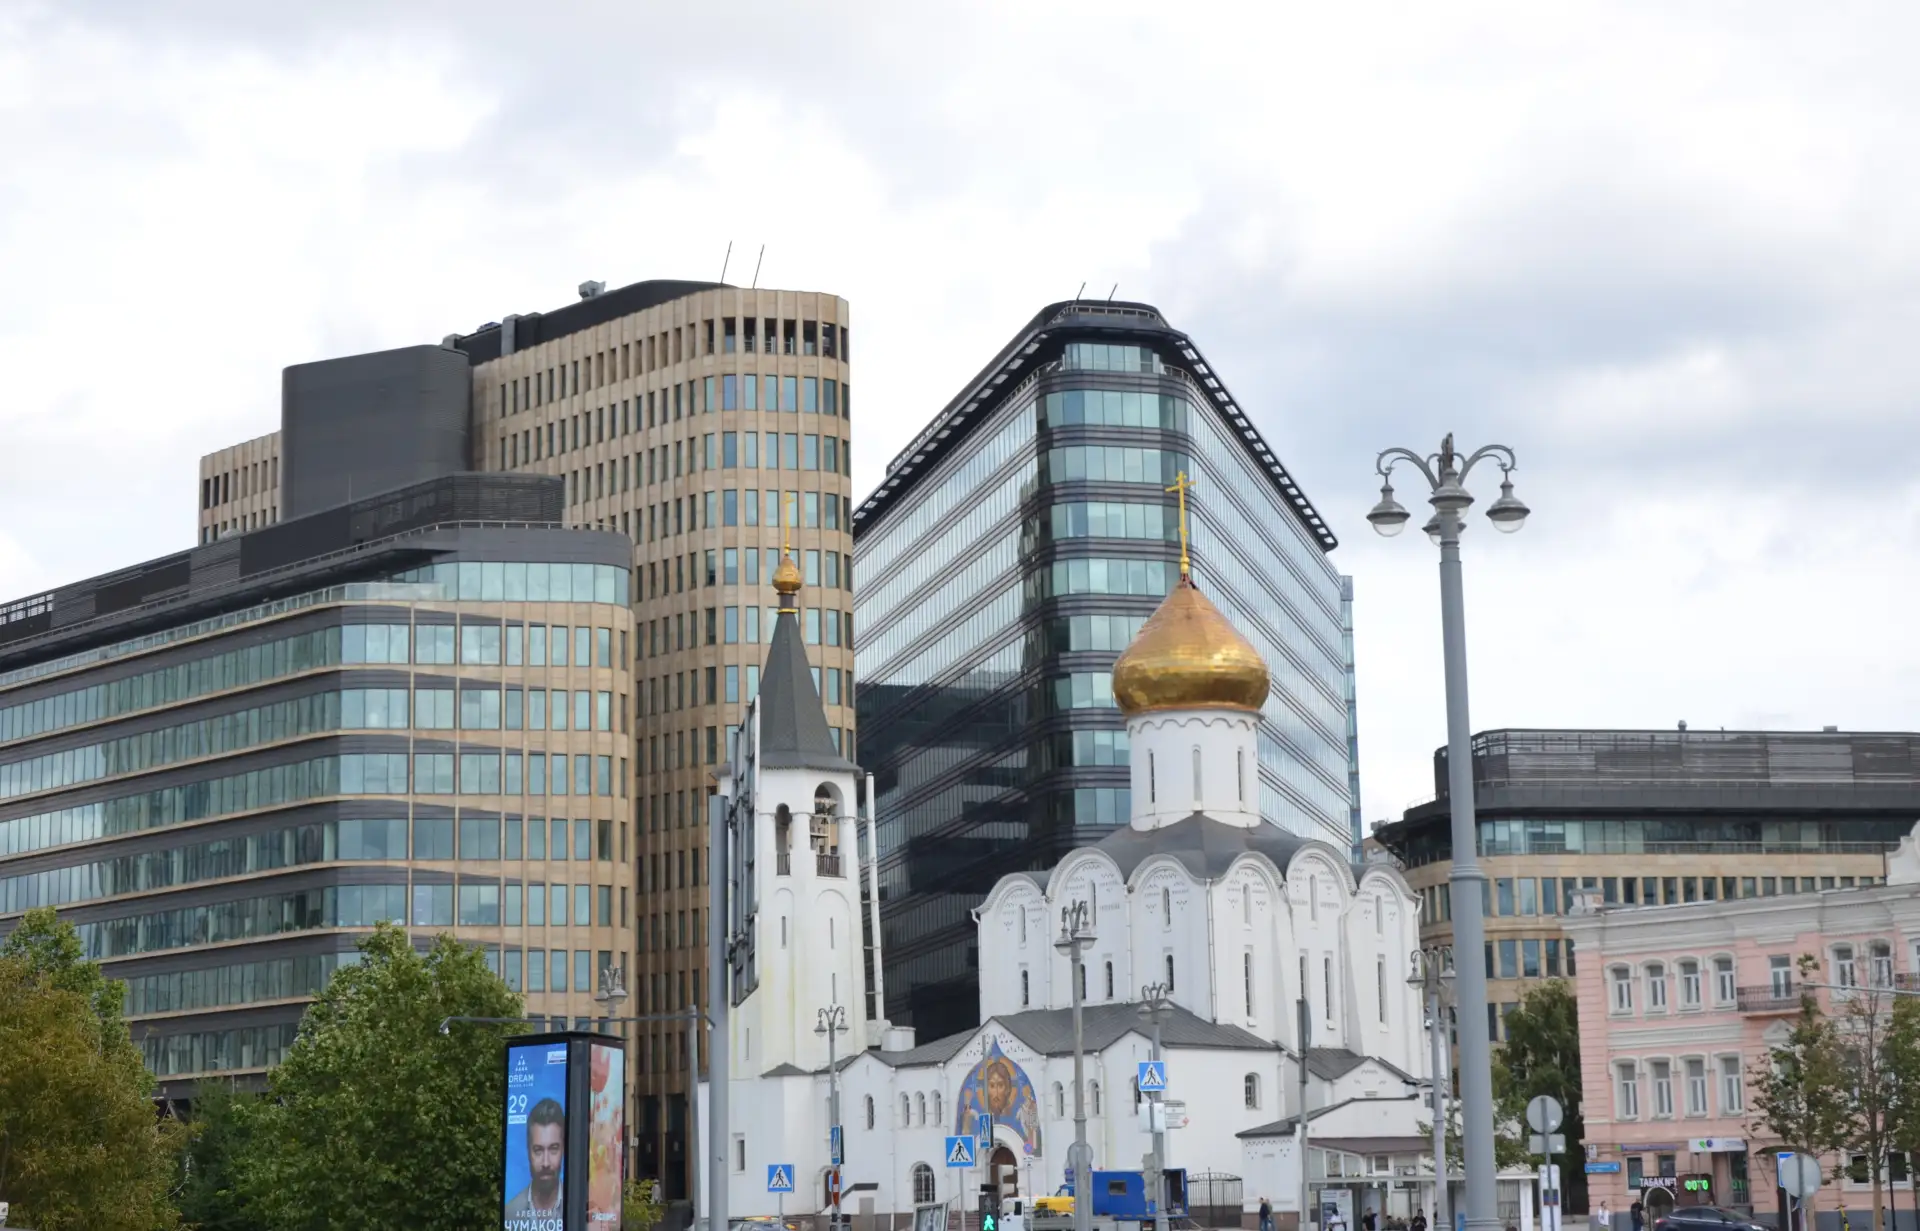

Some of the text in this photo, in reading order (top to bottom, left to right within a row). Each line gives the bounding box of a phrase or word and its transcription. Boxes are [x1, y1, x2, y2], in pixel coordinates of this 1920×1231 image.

[509, 1074, 534, 1083] DREAM
[509, 1094, 528, 1113] 29
[1639, 1177, 1664, 1187] ТАБАК
[505, 1219, 564, 1231] ЧУМАКОВ
